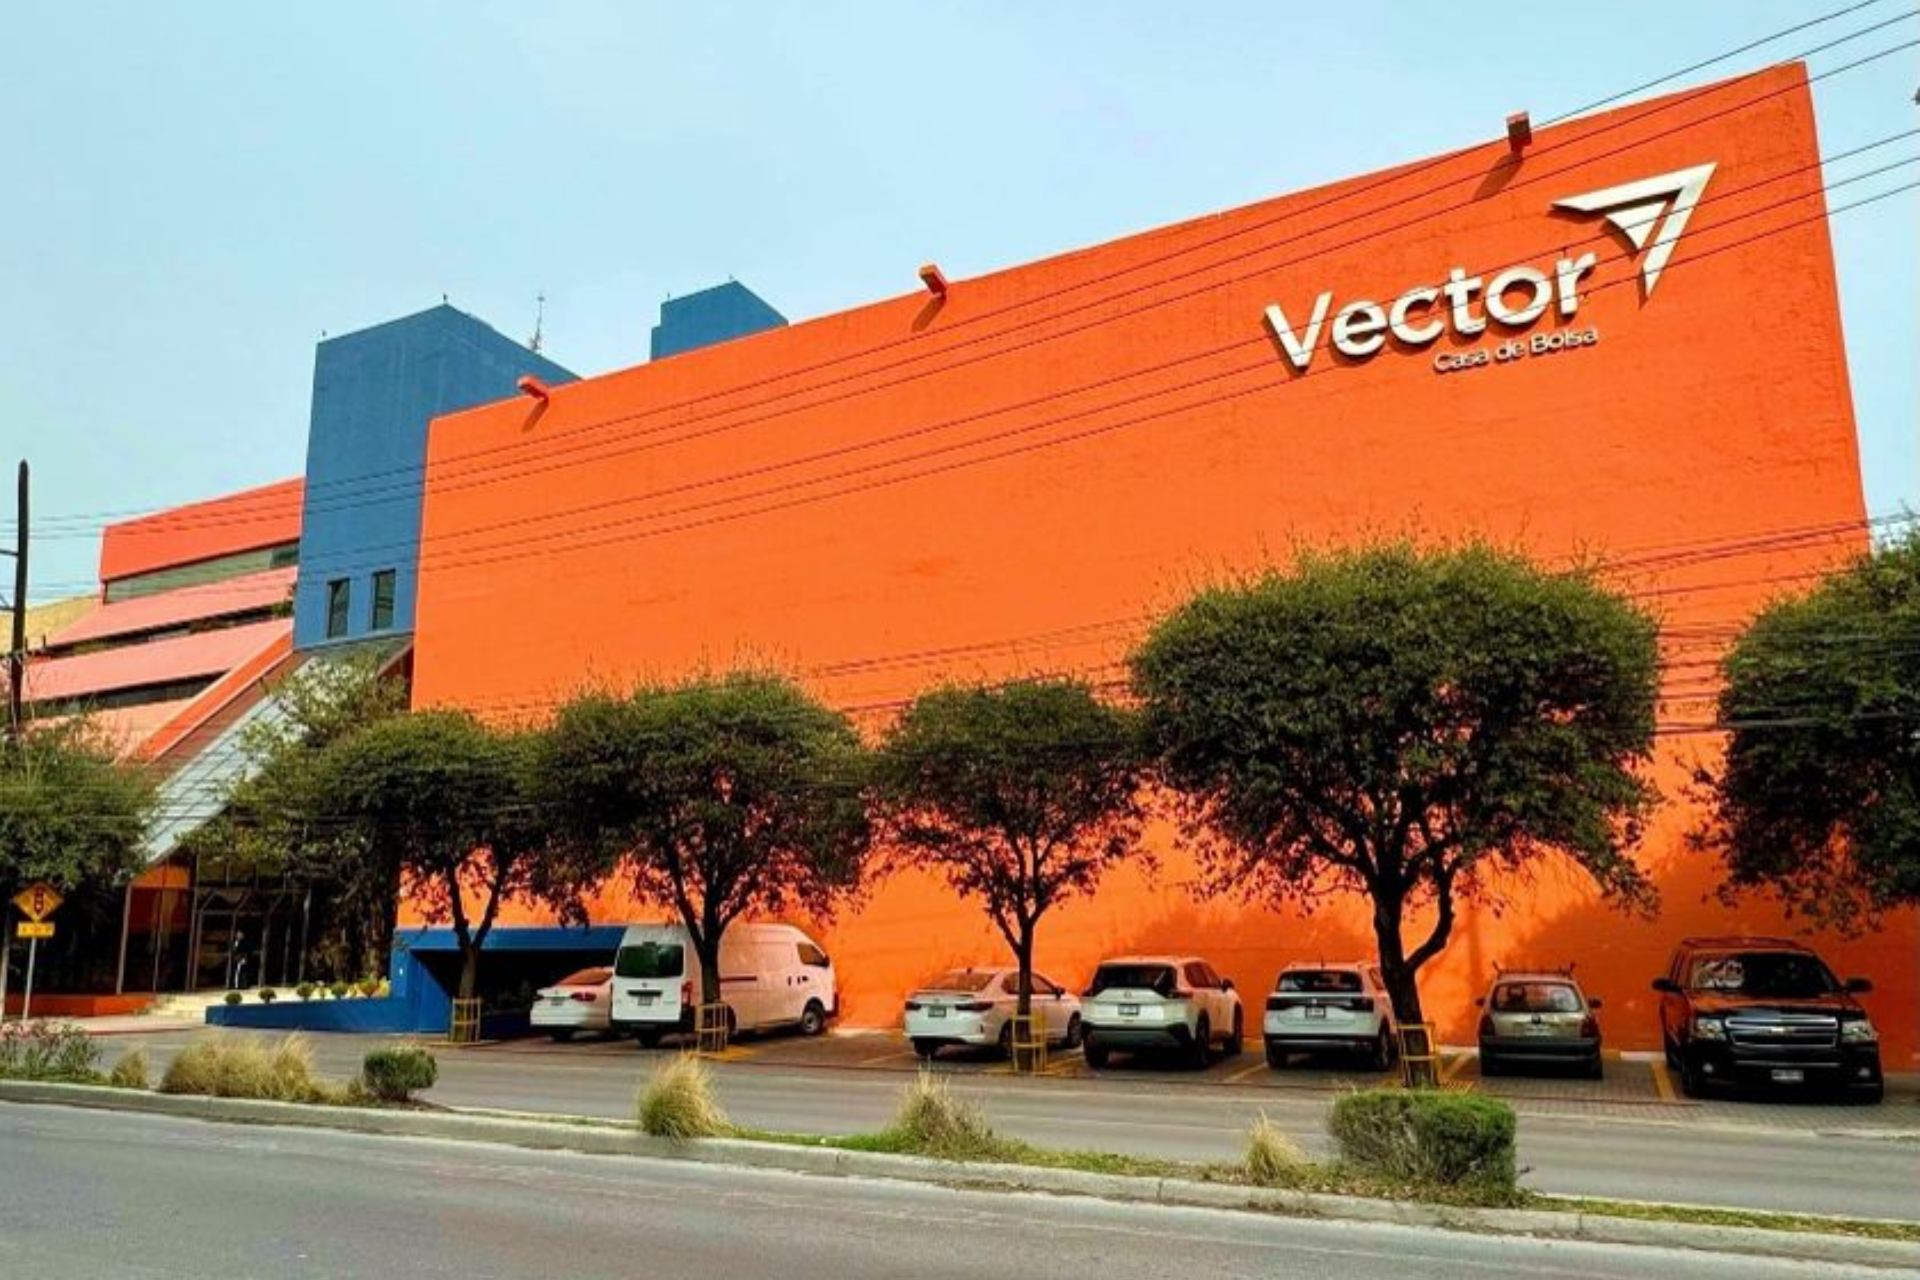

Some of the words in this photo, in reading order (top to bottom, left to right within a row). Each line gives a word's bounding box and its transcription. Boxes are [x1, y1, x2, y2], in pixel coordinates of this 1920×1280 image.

[1264, 252, 1597, 368] Vector
[1435, 350, 1489, 372] Casa
[1496, 339, 1526, 360] de
[1531, 328, 1598, 353] Bolsa
